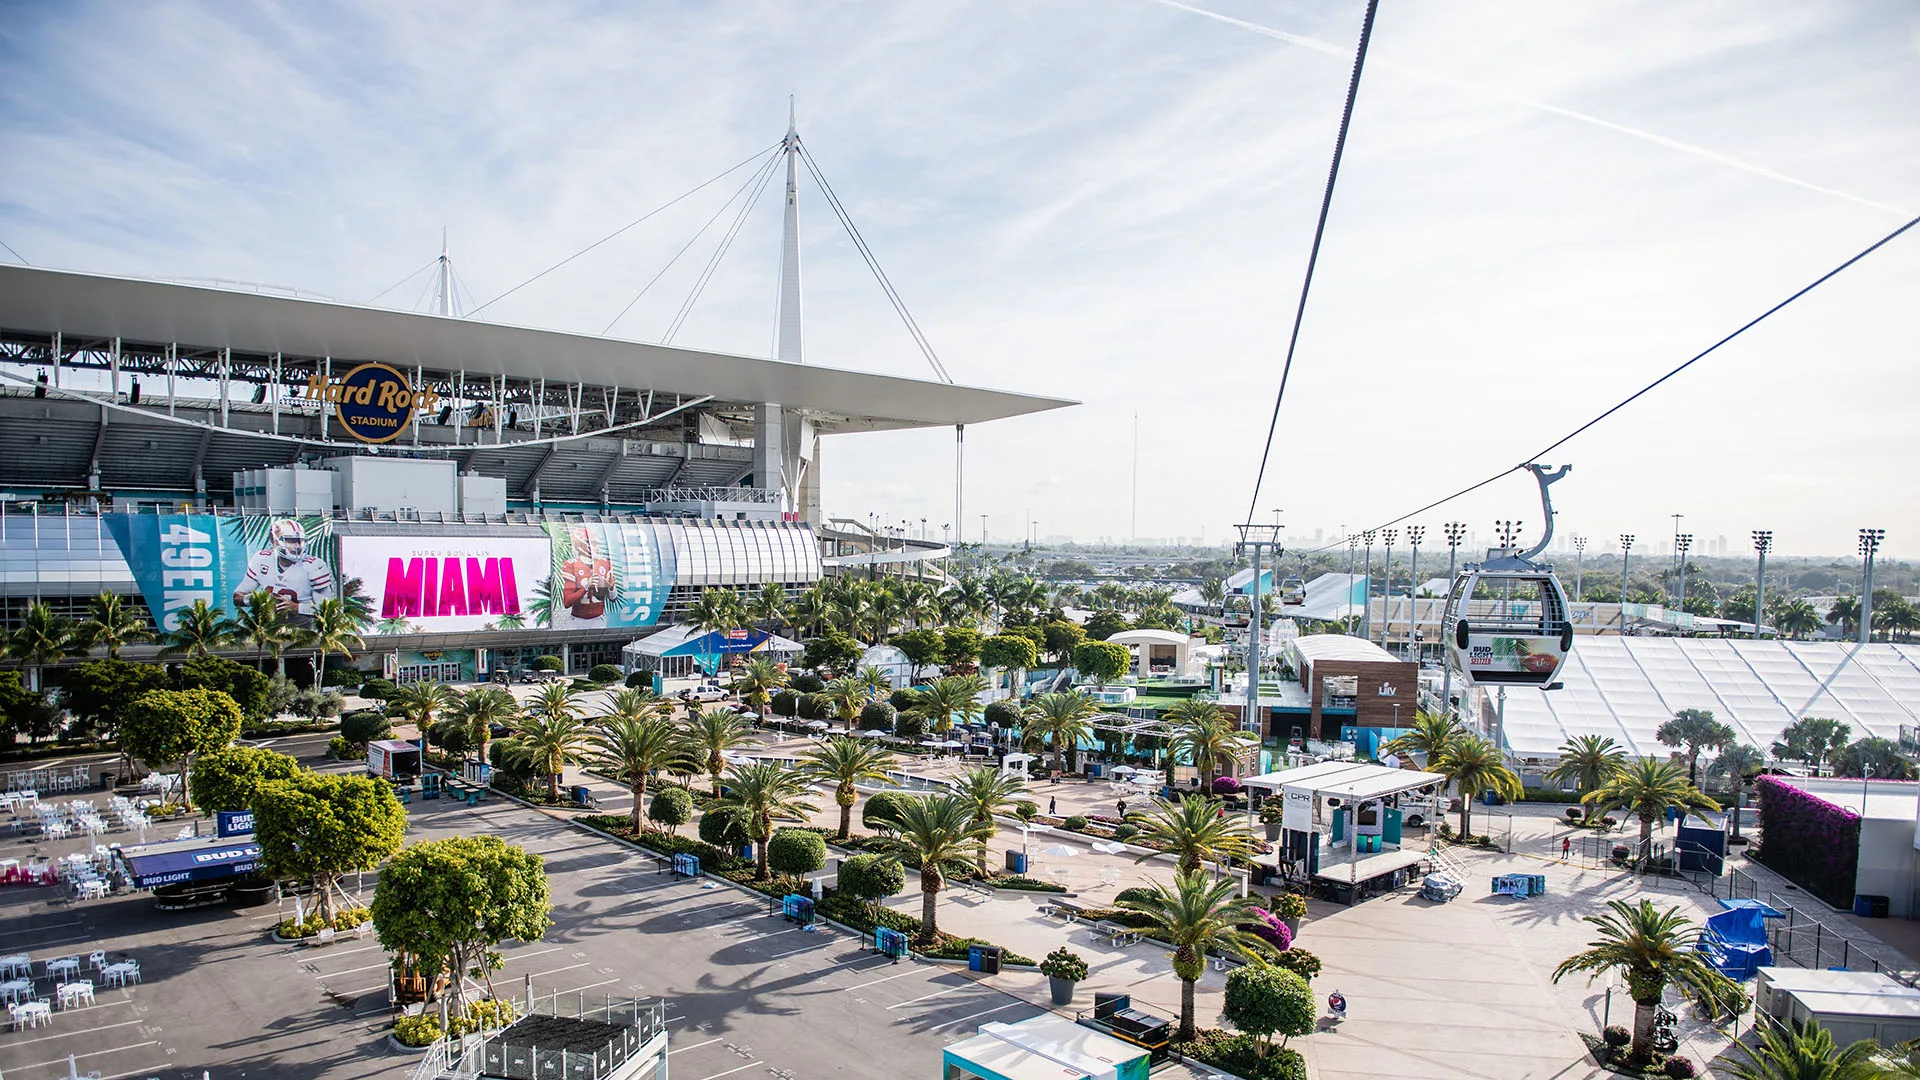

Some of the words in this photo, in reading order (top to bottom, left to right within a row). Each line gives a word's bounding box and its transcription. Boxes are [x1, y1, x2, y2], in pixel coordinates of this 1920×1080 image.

[305, 374, 377, 406] Hard
[377, 380, 440, 415] Rock
[350, 415, 397, 428] STADIUM
[617, 529, 652, 622] CHIEFS
[381, 557, 520, 618] MIAMI
[1290, 792, 1311, 802] CPR
[232, 814, 254, 824] BUD
[195, 850, 243, 862] BUD
[234, 863, 253, 872] BUD
[143, 876, 162, 886] BUD
[163, 871, 190, 882] LIGHT
